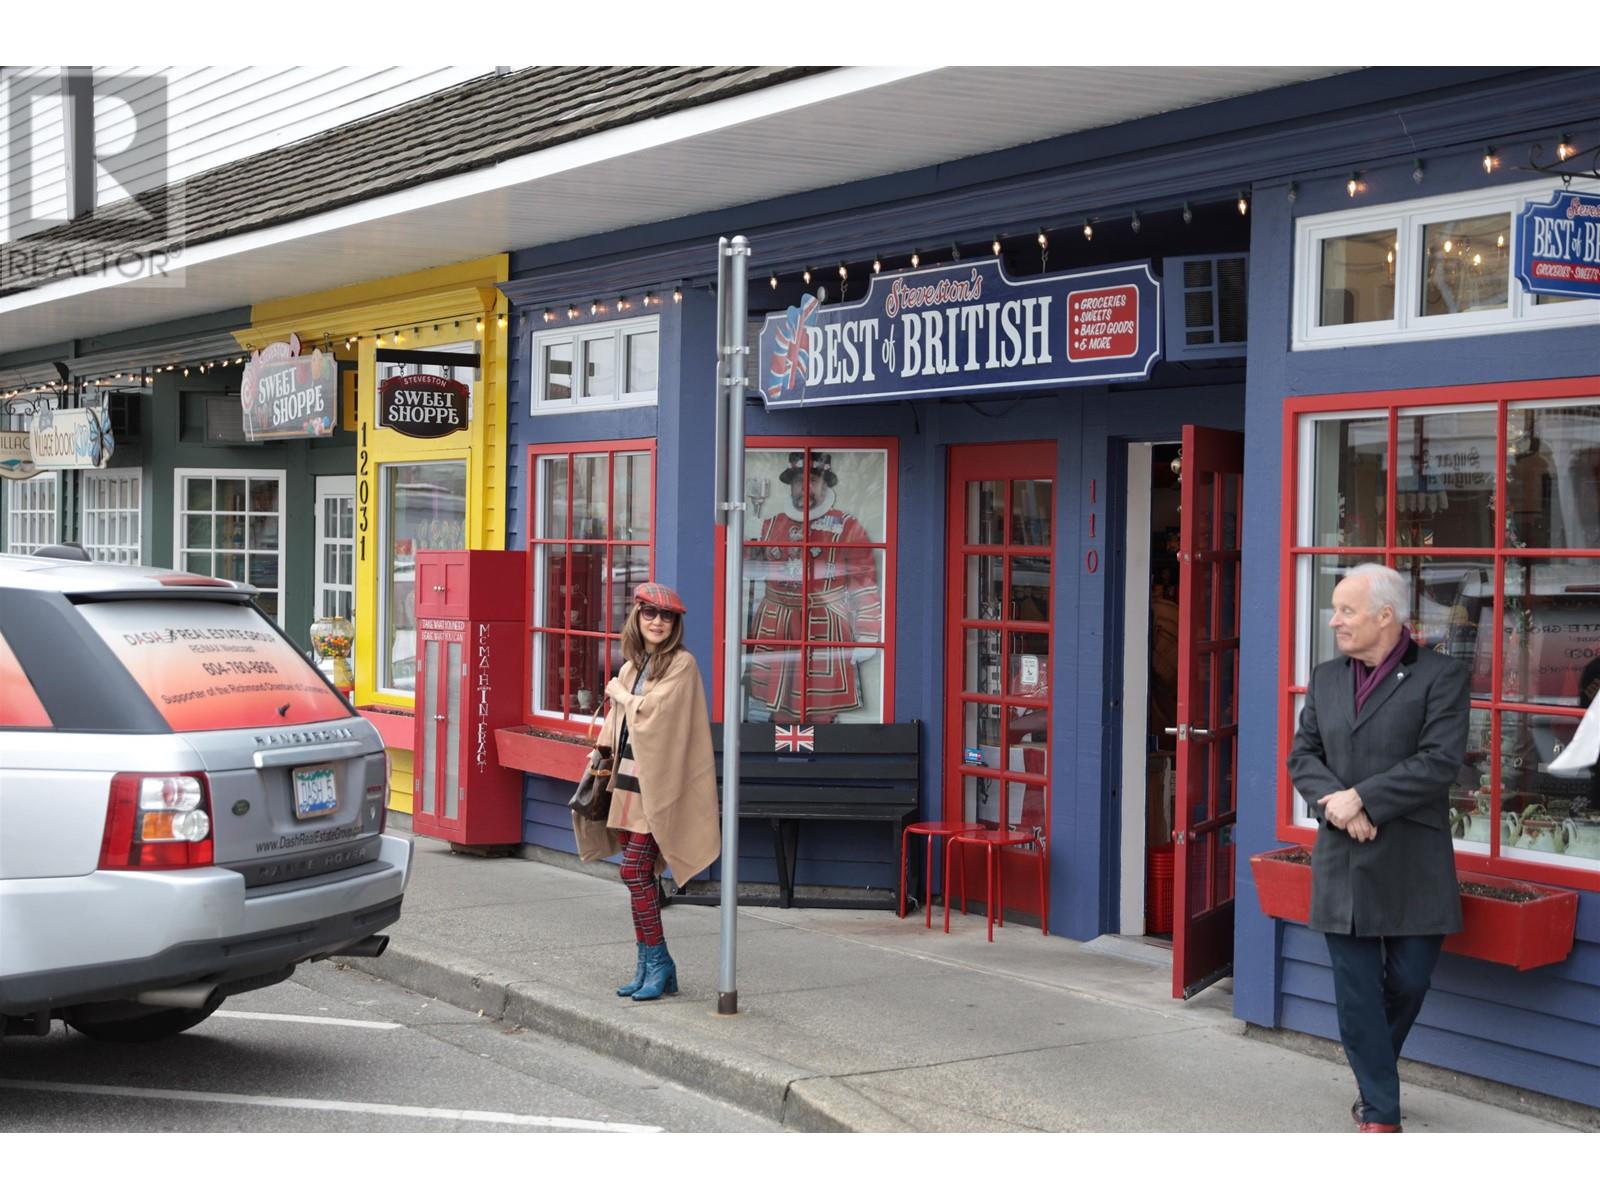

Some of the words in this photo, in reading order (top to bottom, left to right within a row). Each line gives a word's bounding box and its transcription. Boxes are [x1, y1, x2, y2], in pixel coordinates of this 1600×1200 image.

[1532, 216, 1574, 260] BEST
[1571, 227, 1582, 257] of
[1536, 263, 1571, 278] GROCERIES
[1575, 266, 1600, 280] SWEETS
[885, 268, 983, 318] Steveston's
[1080, 294, 1127, 310] GROCERIES
[1080, 308, 1112, 323] SWEETS
[1080, 322, 1106, 336] BAKED
[1106, 320, 1135, 334] GOODS
[806, 318, 880, 387] BEST
[882, 323, 896, 373] of
[900, 296, 1053, 377] BRITISH
[1079, 338, 1088, 351] &
[1088, 336, 1112, 350] MORE
[258, 367, 297, 404] SWEET
[404, 375, 447, 388] STEVESTON
[272, 385, 325, 426] SHOPPE
[394, 390, 454, 407] SWEET
[388, 405, 460, 425] SHOPPE
[359, 421, 369, 561] 12031
[1085, 479, 1099, 574] 110
[123, 631, 162, 646] DASH
[176, 629, 207, 640] REAL
[207, 628, 246, 640] ESTATE
[161, 689, 205, 705] Supporter
[206, 686, 216, 697] of
[327, 779, 334, 800] 5
